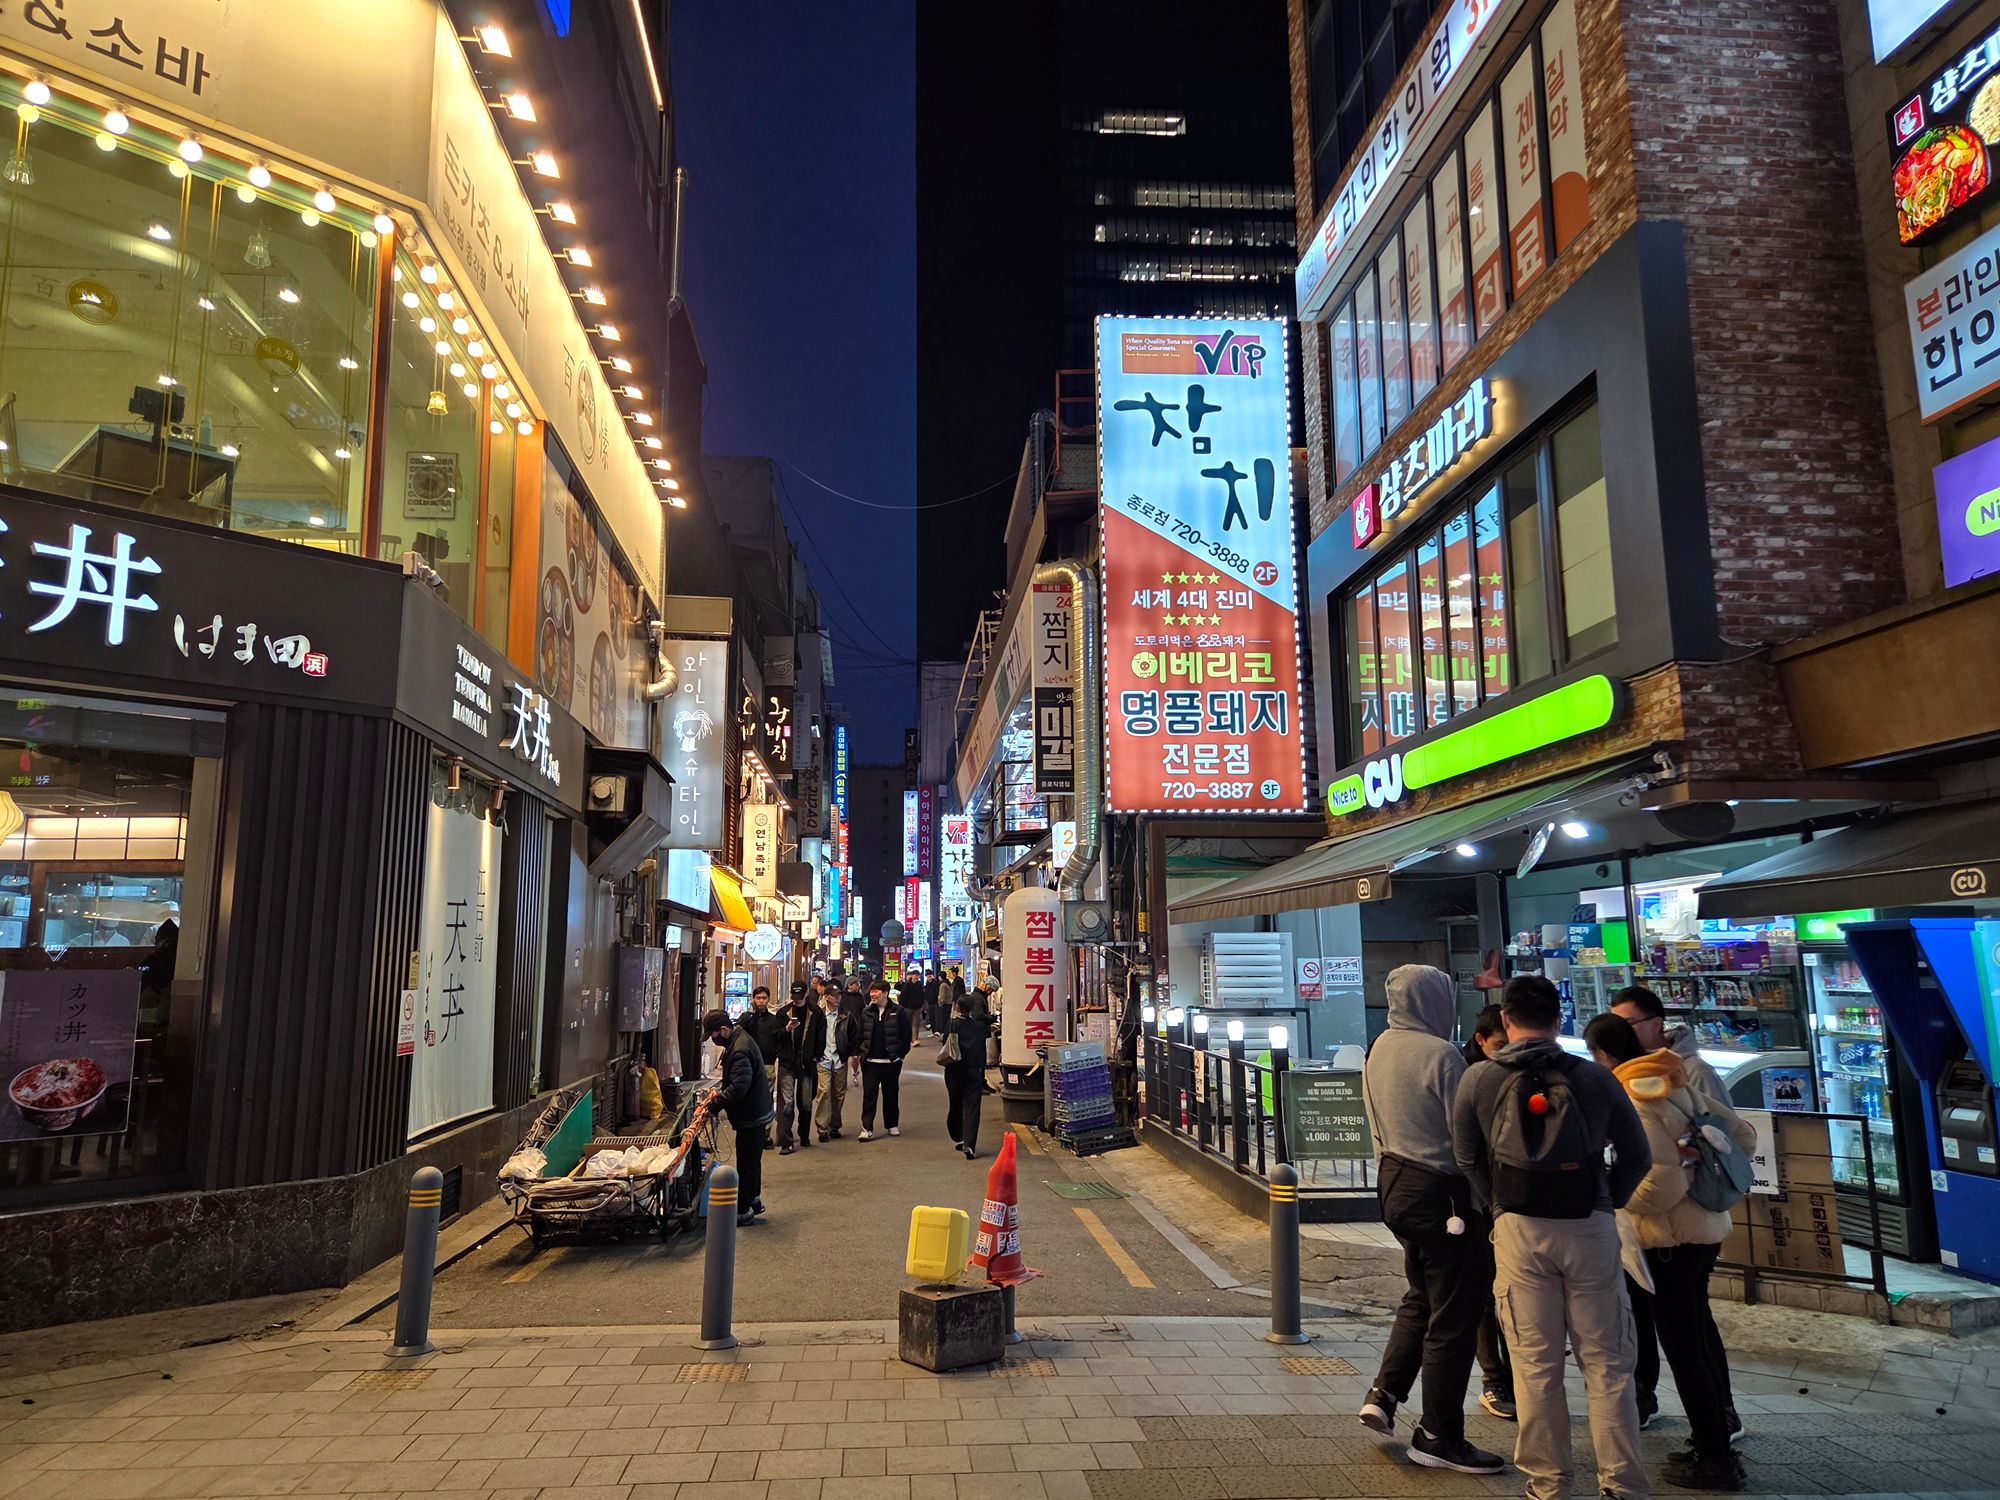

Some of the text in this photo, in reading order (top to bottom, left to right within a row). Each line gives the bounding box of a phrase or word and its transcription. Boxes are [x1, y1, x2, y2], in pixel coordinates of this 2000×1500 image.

[86, 17, 210, 96] 소바
[444, 132, 491, 257] 돈카츠
[504, 262, 530, 331] 소바
[1194, 329, 1267, 379] VIP
[1114, 384, 1275, 531] 참치
[1127, 493, 1277, 582] 종로점 720-3888 2F
[0, 518, 163, 646] 丼
[1056, 596, 1072, 609] 24
[1131, 589, 1253, 610] 세계 4대 진미
[173, 614, 311, 668] はま田
[1042, 611, 1073, 639] 짬
[1134, 634, 1193, 647] 도토리먹은
[1043, 642, 1073, 670] 지
[1131, 650, 1276, 685] 이베리코
[452, 699, 488, 738] HAMADA
[510, 681, 551, 770] 天丼
[1120, 690, 1289, 736] 명품돼지
[680, 652, 707, 836] 와인슈타인
[906, 735, 916, 747] J
[1162, 743, 1250, 775] 전문점
[1161, 782, 1278, 800] 720-3887 3F
[1332, 788, 1358, 807] Nice to
[1364, 753, 1403, 809] CU
[755, 829, 767, 877] 연남족발
[921, 802, 930, 868] 아쿠아마사지
[1957, 875, 1980, 890] CU
[441, 898, 468, 1043] 天丼
[1024, 911, 1056, 1050] 짬뽕지존
[62, 983, 87, 1043] カツ丼
[1299, 1116, 1365, 1126] 우리 점포 가격인하
